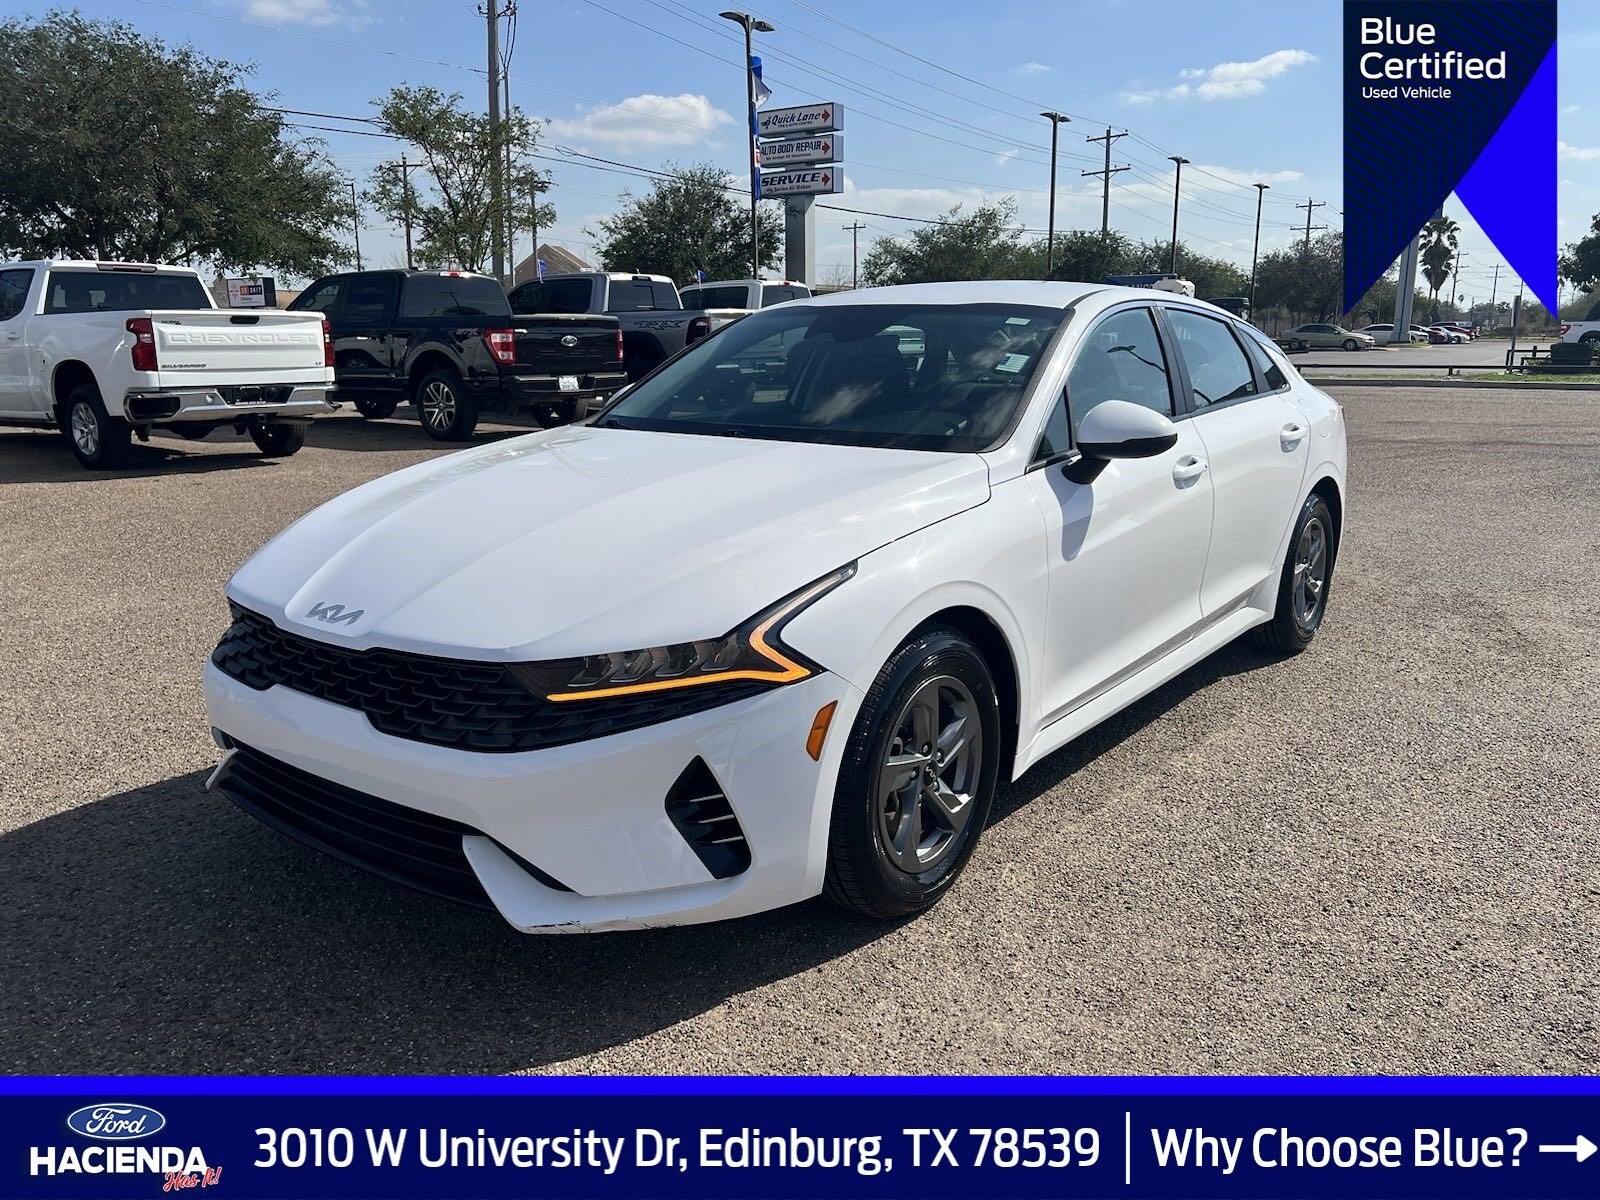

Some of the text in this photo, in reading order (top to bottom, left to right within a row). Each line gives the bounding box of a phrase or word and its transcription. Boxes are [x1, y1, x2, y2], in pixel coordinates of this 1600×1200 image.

[771, 112, 821, 125] Quick Lane
[760, 140, 821, 156] AUTO BODY REPAIR
[761, 173, 820, 186] SERVICE
[168, 333, 315, 345] CHEVROLET
